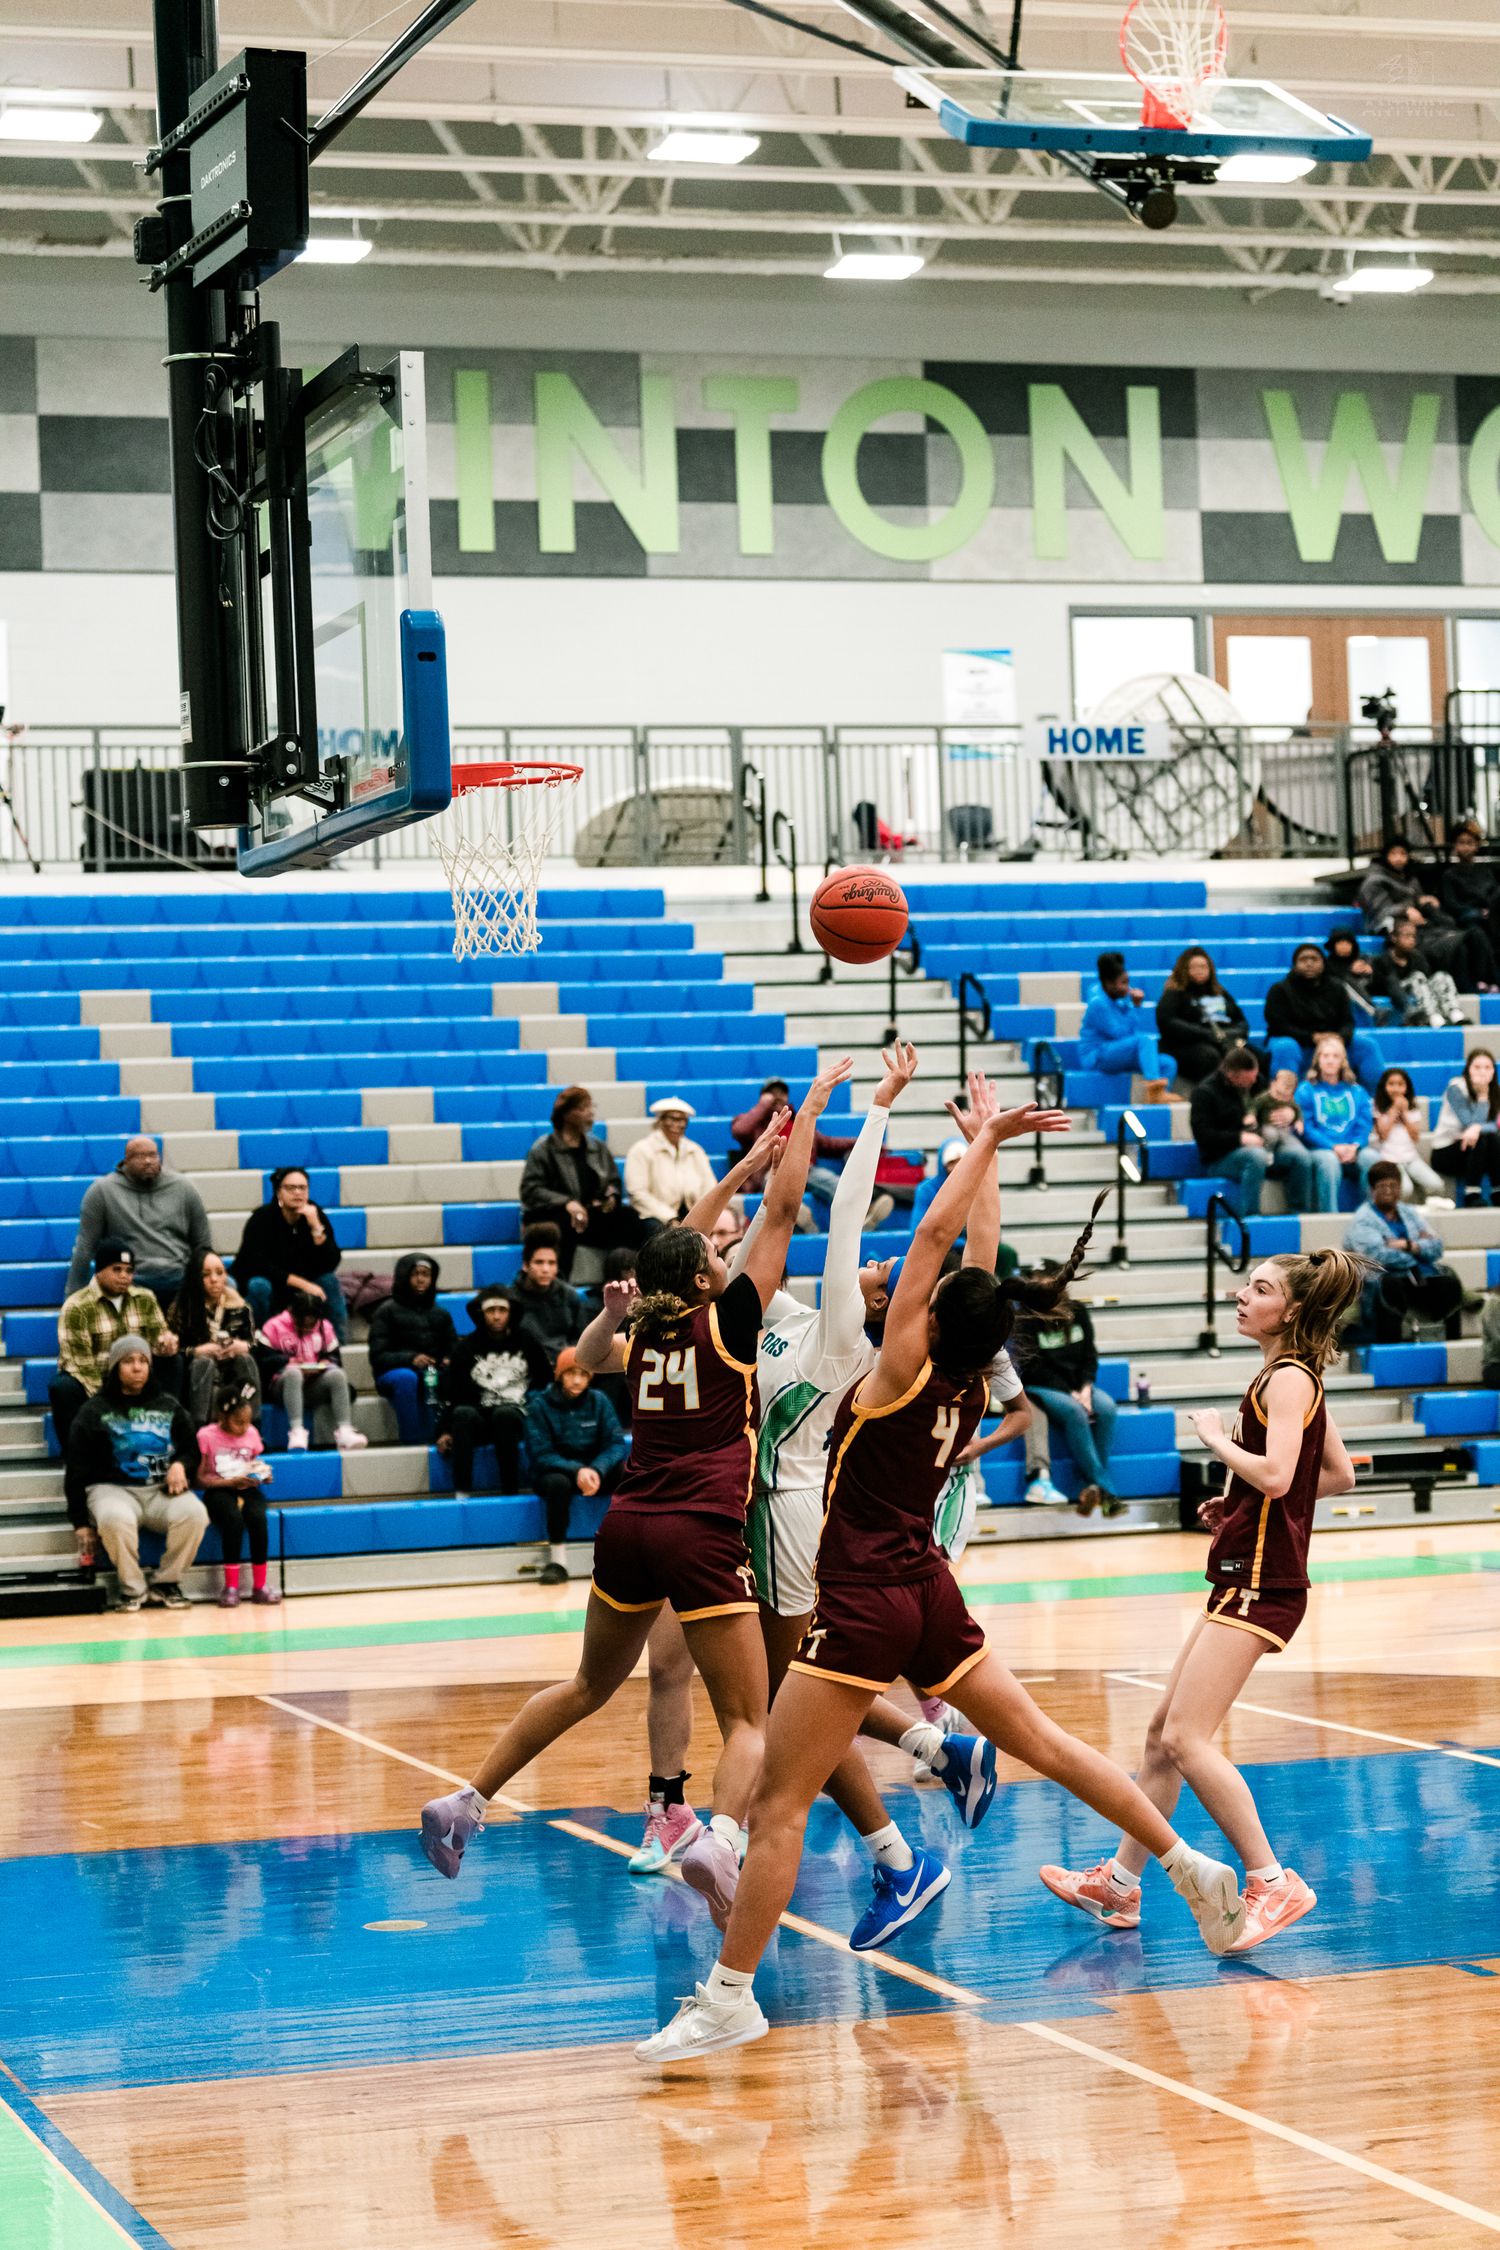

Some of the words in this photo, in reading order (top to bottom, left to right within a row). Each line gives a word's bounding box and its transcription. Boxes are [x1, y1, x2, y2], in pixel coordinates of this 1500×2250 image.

[200, 150, 237, 189] DAKTRONICS
[1048, 727, 1146, 755] HOME
[842, 881, 900, 904] Rawlings
[638, 1345, 700, 1411] 24
[931, 1406, 960, 1468] 4
[1238, 1587, 1261, 1617] T
[806, 1629, 828, 1660] T
